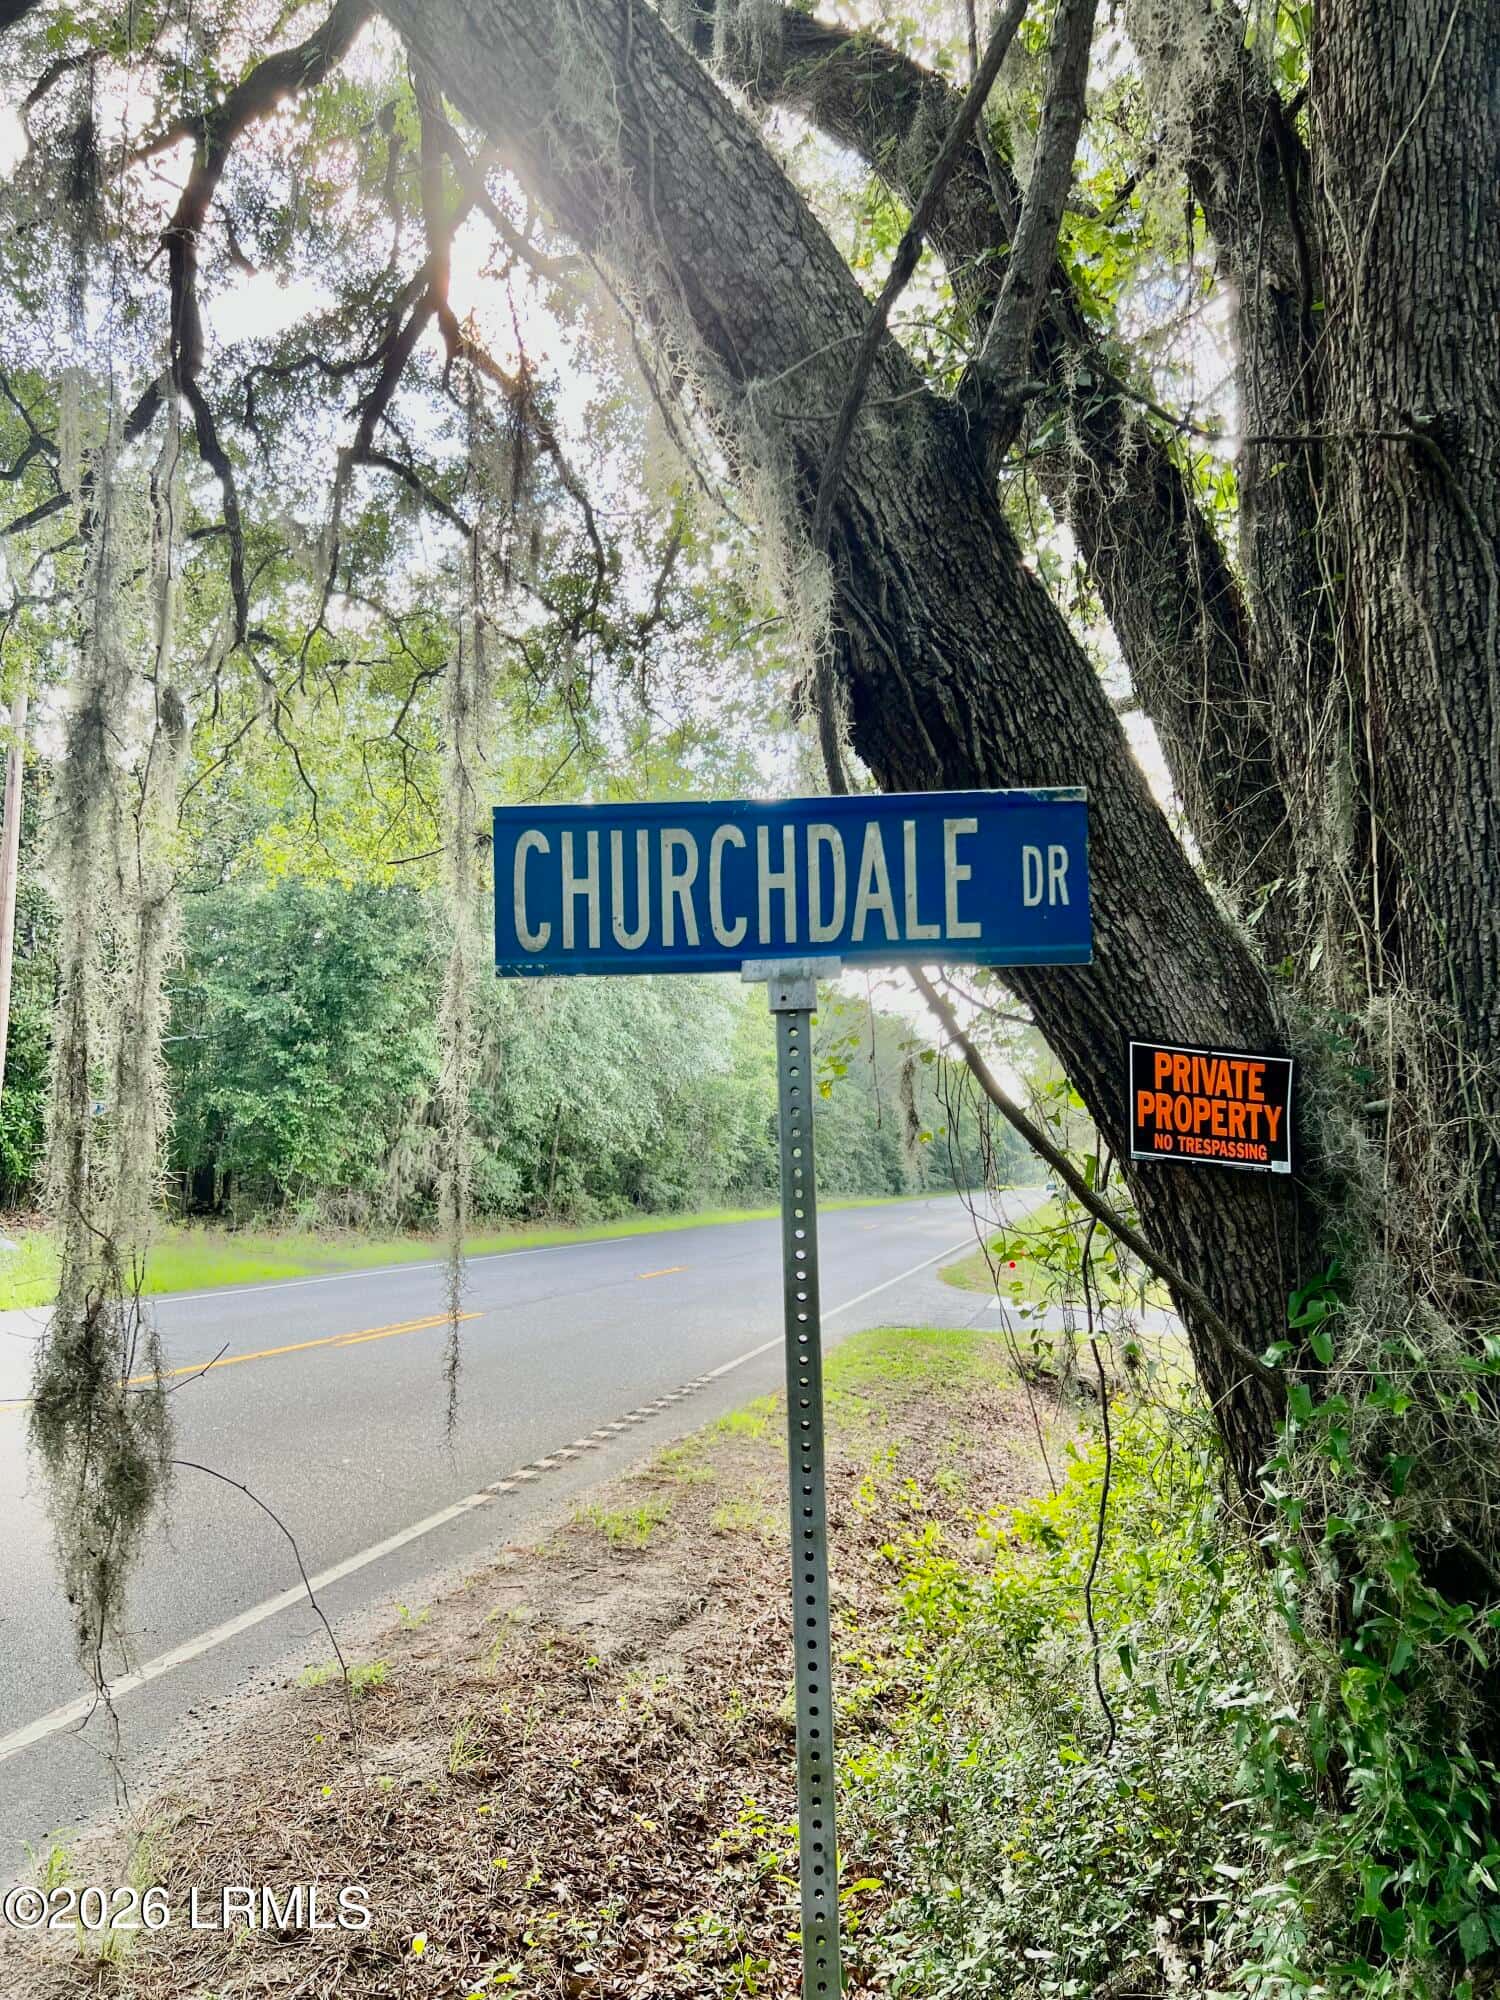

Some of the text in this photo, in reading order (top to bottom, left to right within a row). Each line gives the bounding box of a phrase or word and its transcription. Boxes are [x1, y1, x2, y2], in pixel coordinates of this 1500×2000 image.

[514, 818, 1069, 951] CHURCHDALE DR
[1154, 1051, 1266, 1101] PRIVATE
[1137, 1090, 1282, 1142] PROPERTY
[1154, 1133, 1268, 1160] NO TRESPASSING
